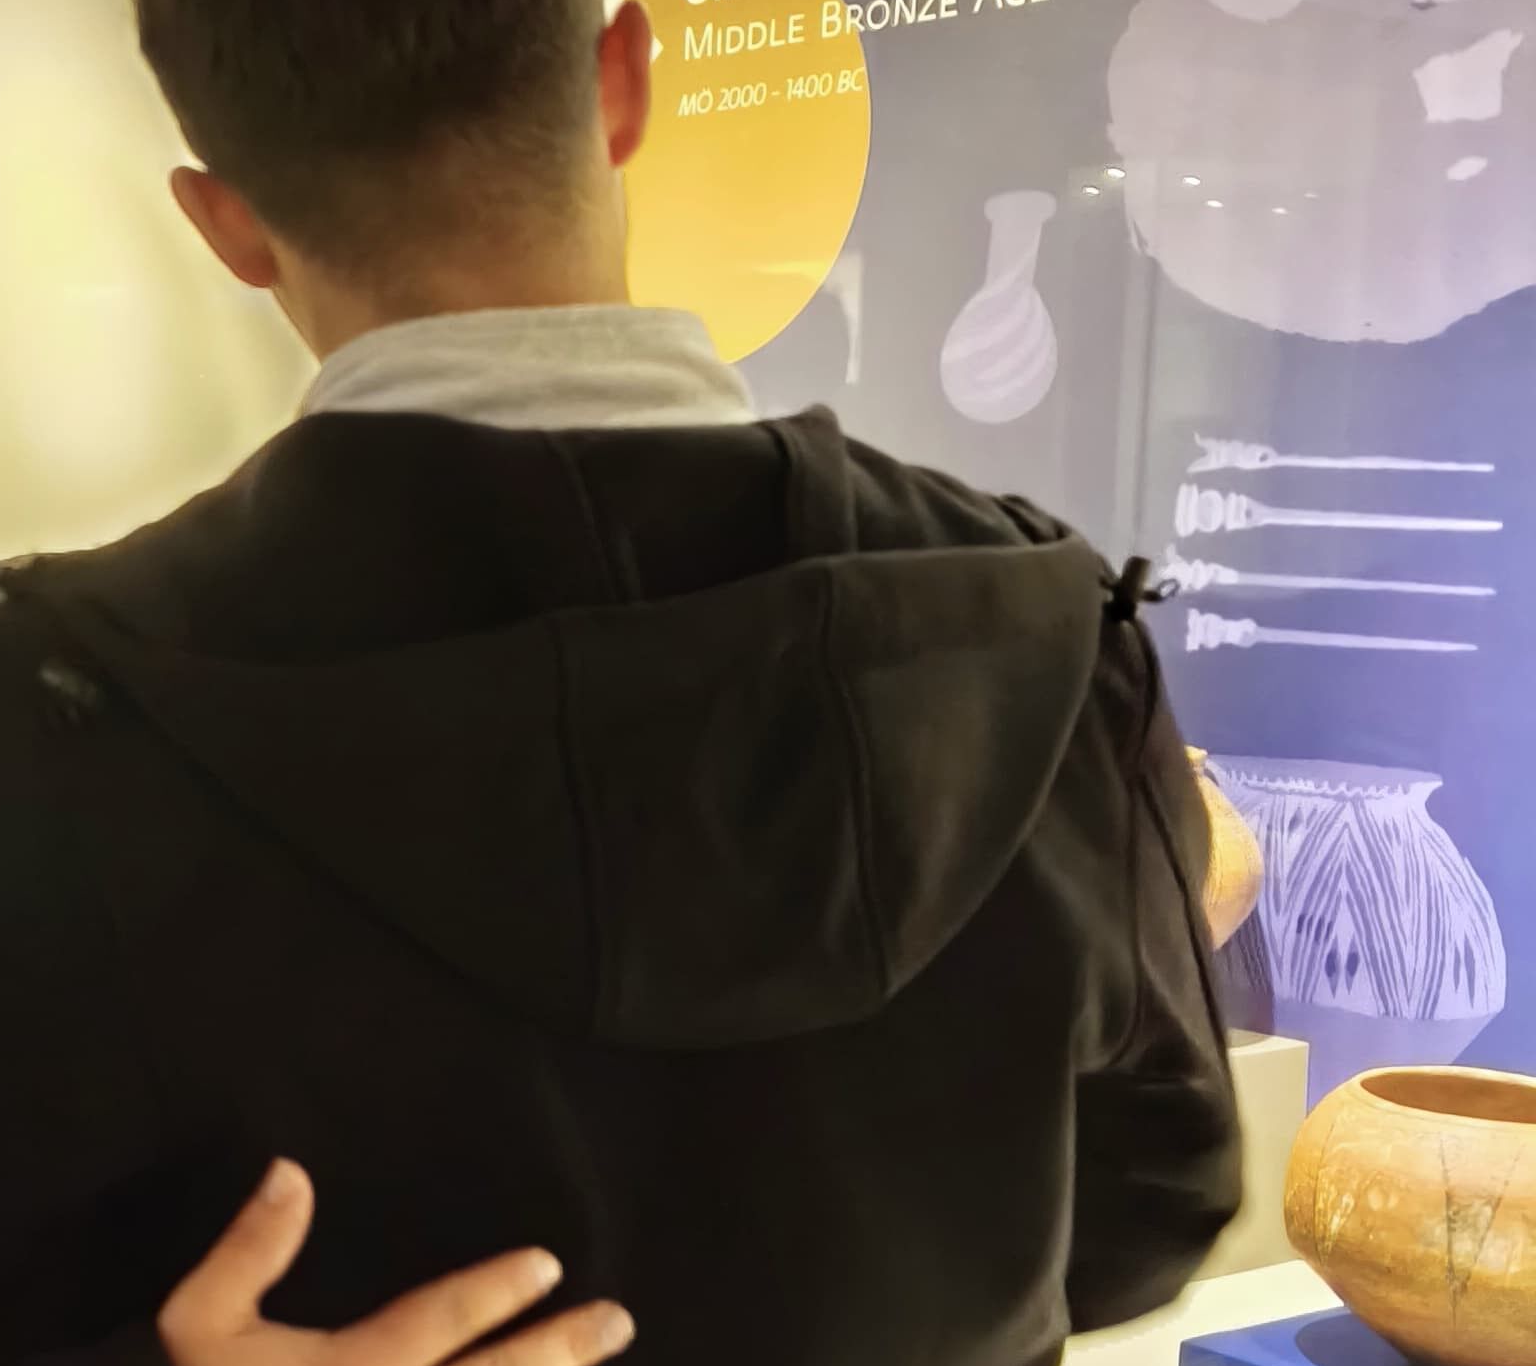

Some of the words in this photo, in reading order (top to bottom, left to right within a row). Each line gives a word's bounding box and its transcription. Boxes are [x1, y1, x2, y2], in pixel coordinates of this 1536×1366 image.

[683, 14, 806, 60] MIDDLE
[677, 86, 714, 117] MÖ
[717, 82, 767, 112] 2000
[786, 72, 833, 100] 1400
[836, 66, 864, 94] BC
